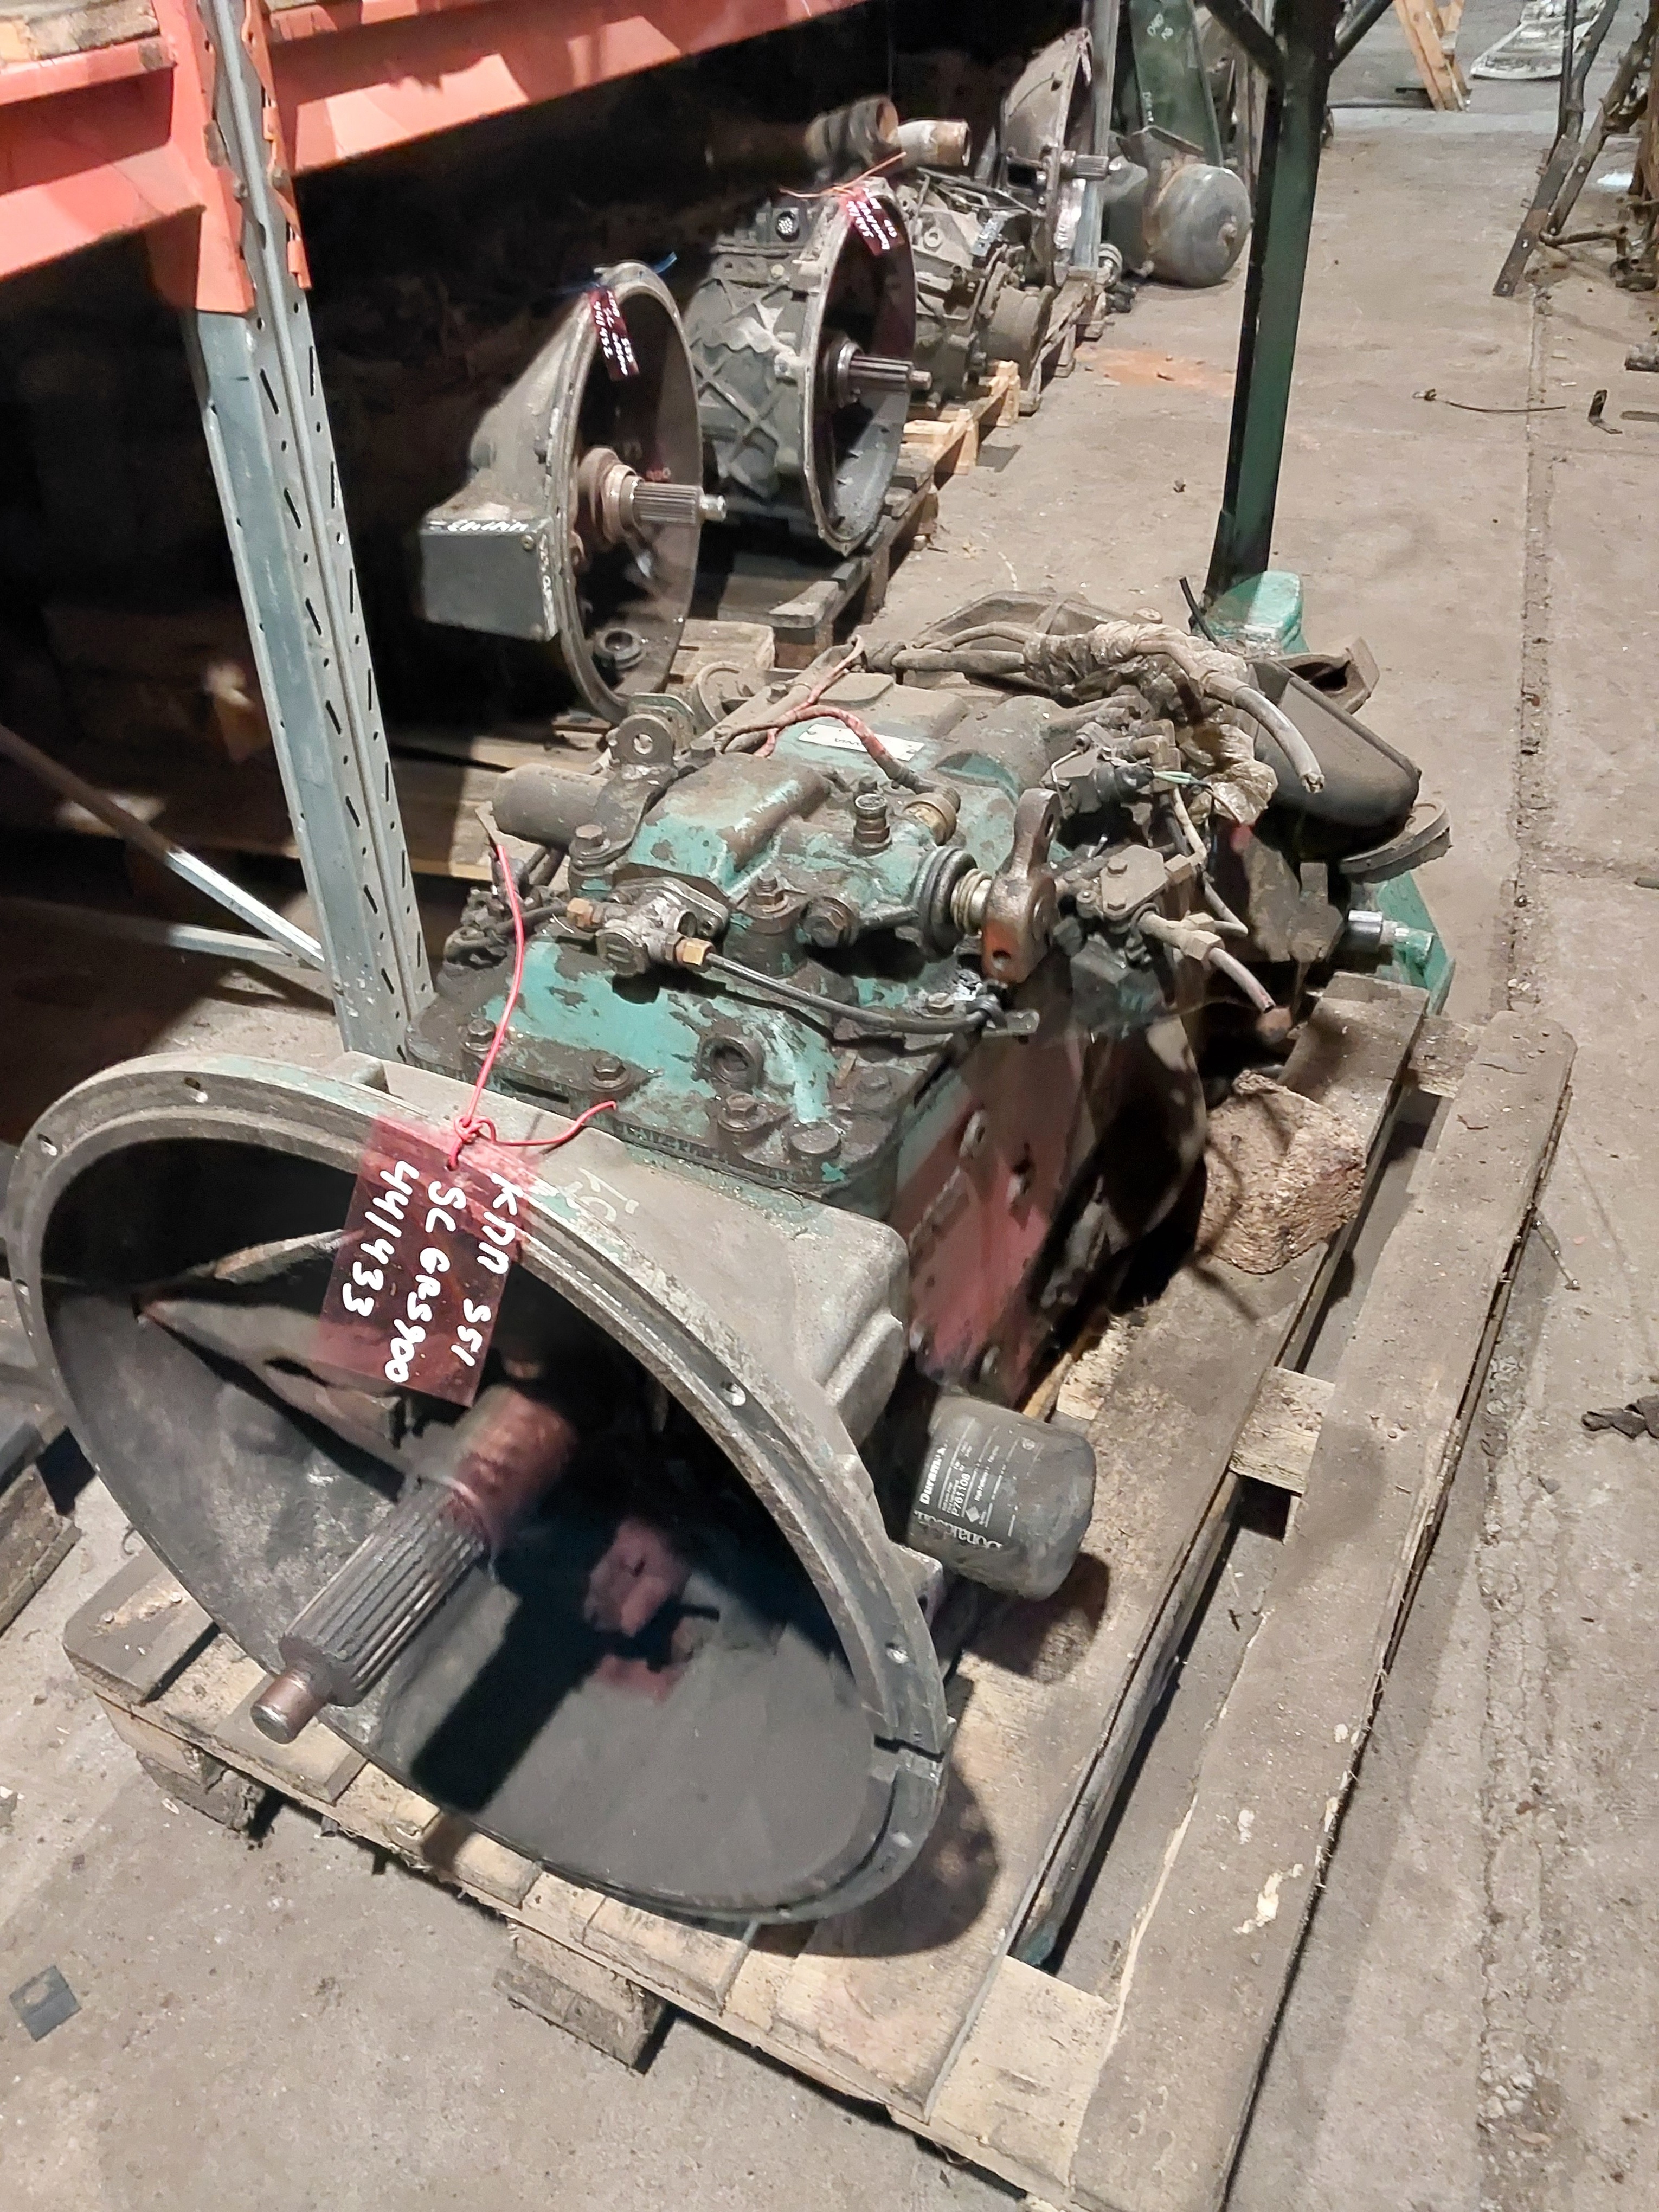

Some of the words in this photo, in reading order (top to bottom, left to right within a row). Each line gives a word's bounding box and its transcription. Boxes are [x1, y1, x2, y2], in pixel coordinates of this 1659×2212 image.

[425, 1181, 466, 1233] SC
[385, 1248, 451, 1382] GRS900
[451, 1298, 491, 1366] 551
